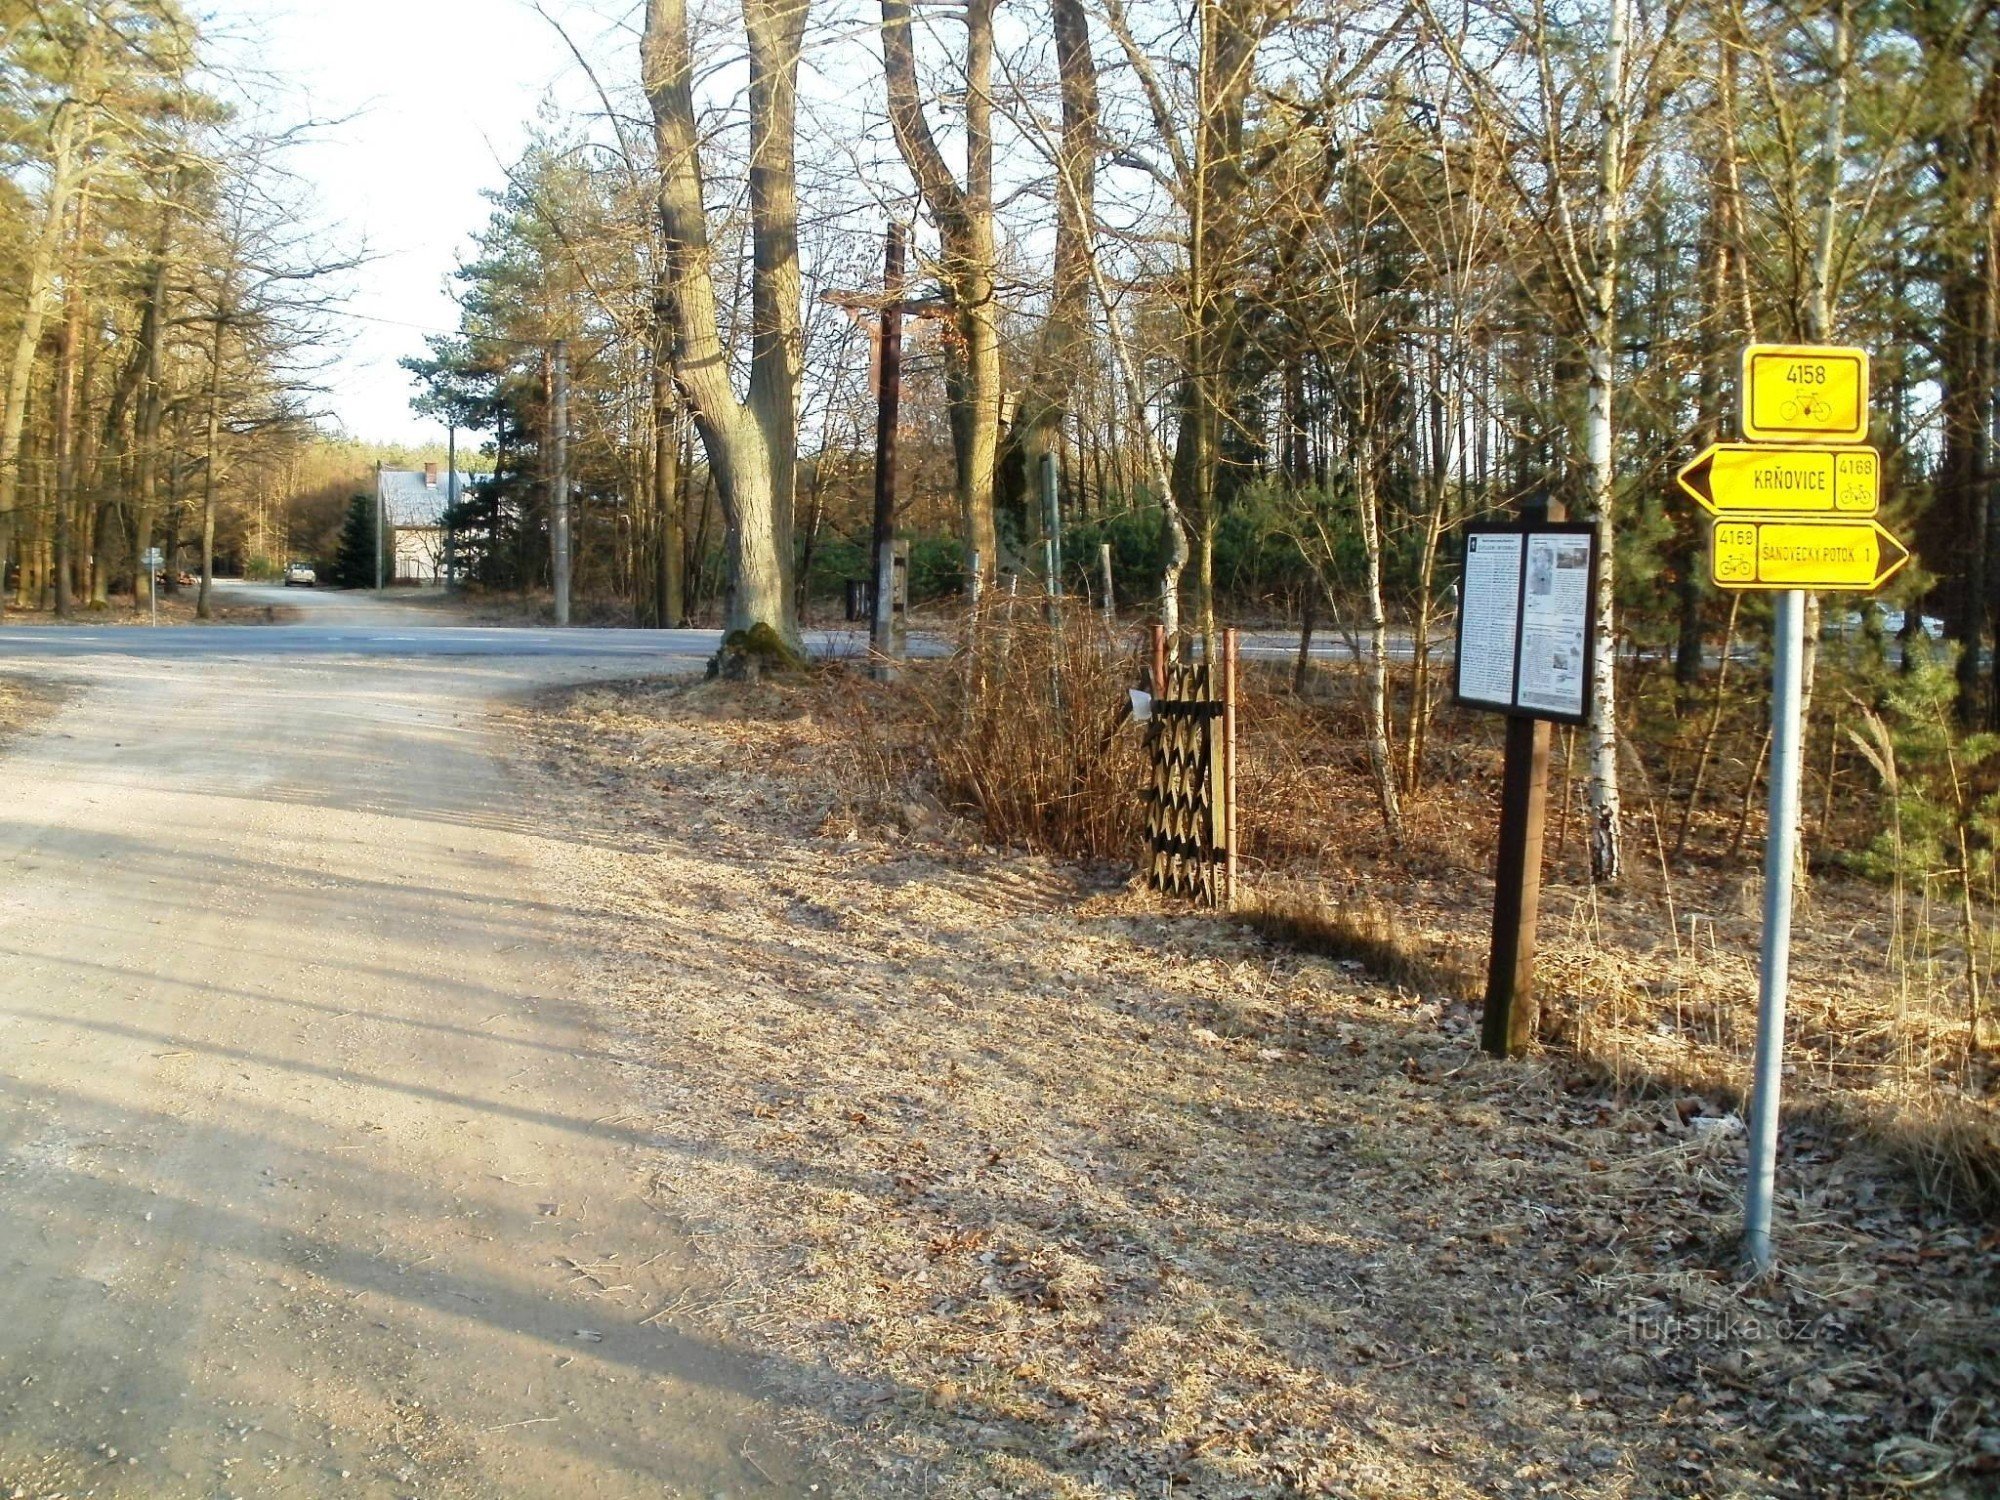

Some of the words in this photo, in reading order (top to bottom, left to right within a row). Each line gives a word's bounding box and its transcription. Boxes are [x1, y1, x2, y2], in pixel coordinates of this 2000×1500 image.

[1786, 365, 1826, 385] 4158
[1839, 460, 1872, 475] 4168
[1754, 466, 1825, 490] KRŇOVICE
[1823, 546, 1855, 562] POTOK
[1865, 547, 1870, 562] 1
